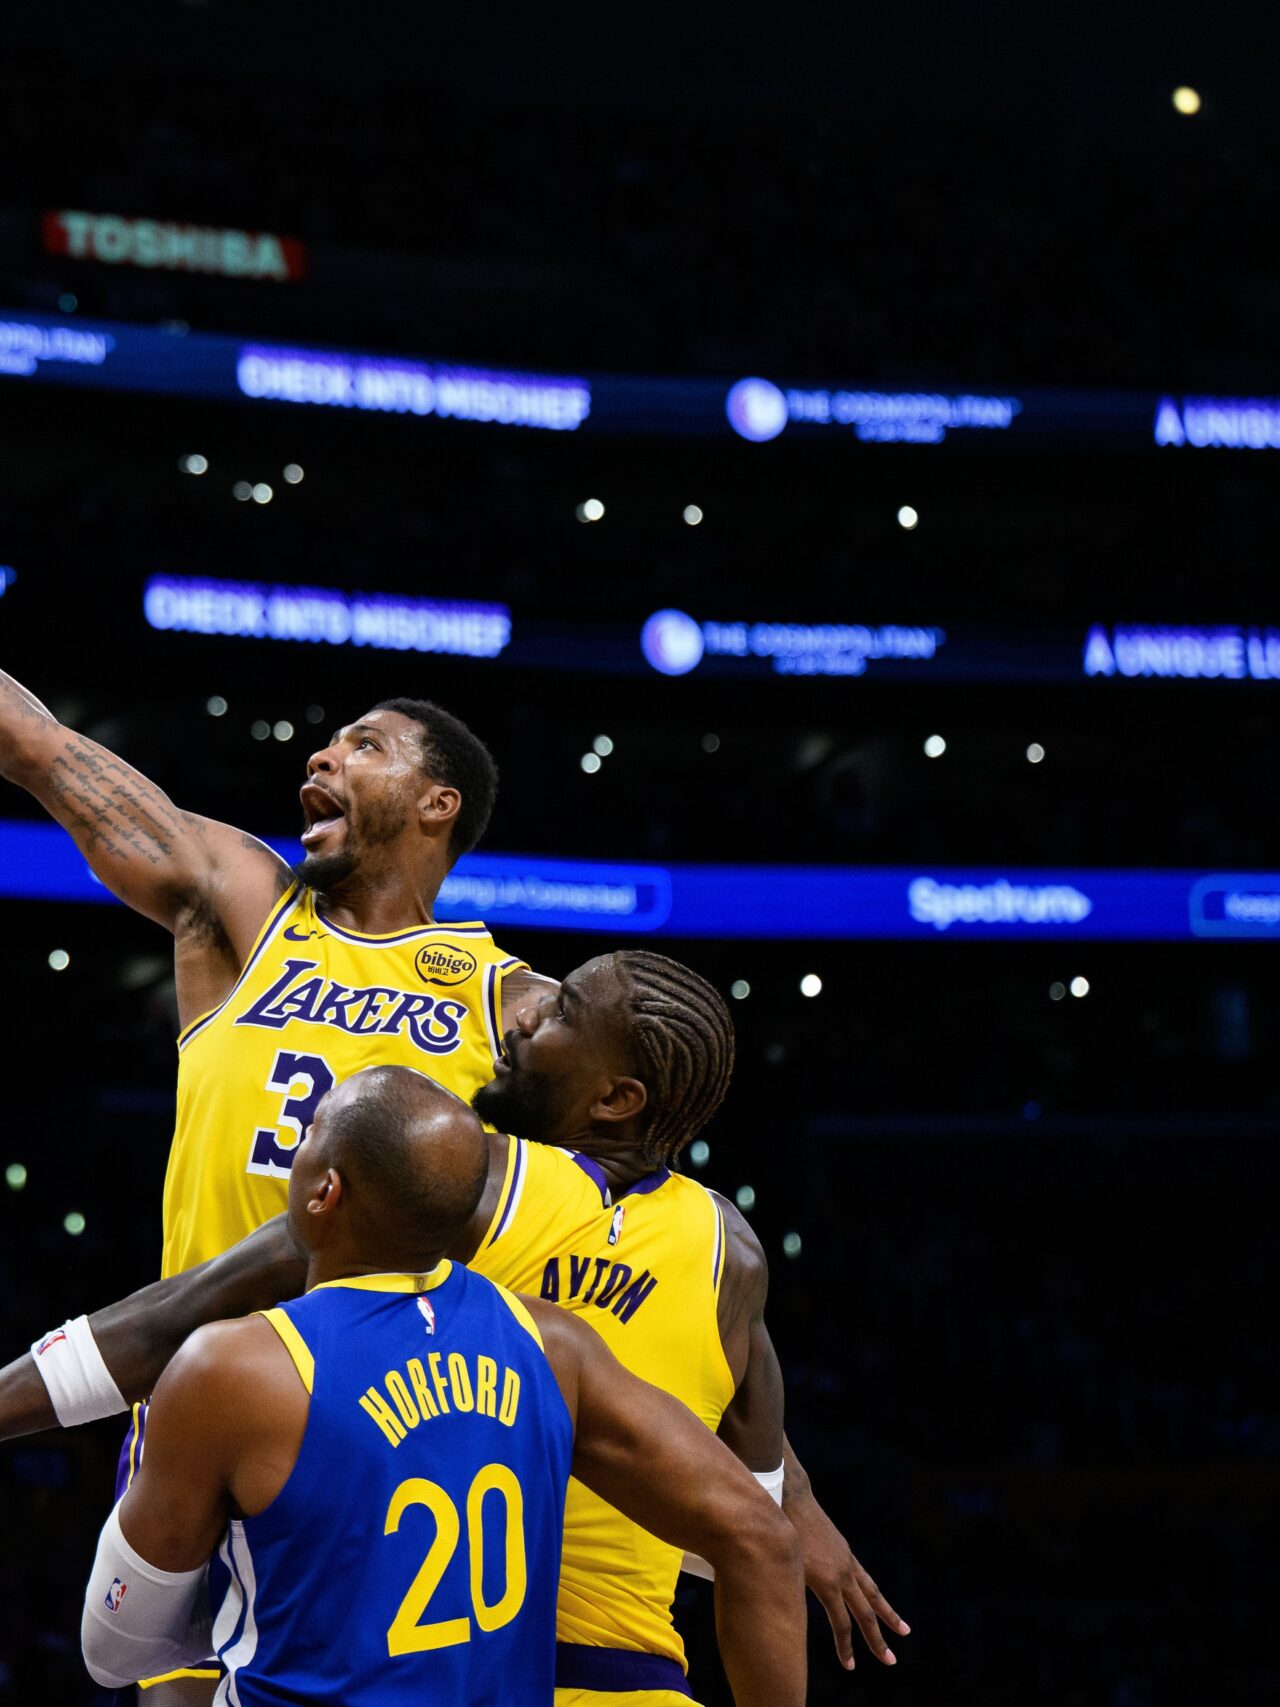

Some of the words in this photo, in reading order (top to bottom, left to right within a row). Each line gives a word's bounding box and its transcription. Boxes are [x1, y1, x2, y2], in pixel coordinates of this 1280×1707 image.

[59, 209, 289, 282] TOSHIBA
[236, 351, 355, 408] CHECK
[356, 362, 436, 416] INTO
[437, 371, 591, 431] MISCHIEF
[1154, 397, 1185, 447] A
[144, 580, 264, 639] CHECK
[265, 590, 350, 645] INTO
[351, 599, 512, 658] MISCHIEF
[1083, 625, 1116, 677] A
[908, 876, 1082, 931] Spectrum
[421, 951, 473, 974] bibigo
[233, 958, 468, 1056] LAKERS
[245, 1048, 338, 1180] 3
[540, 1254, 658, 1325] AYTON
[358, 1352, 521, 1448] HORFORD
[384, 1463, 527, 1657] 20
